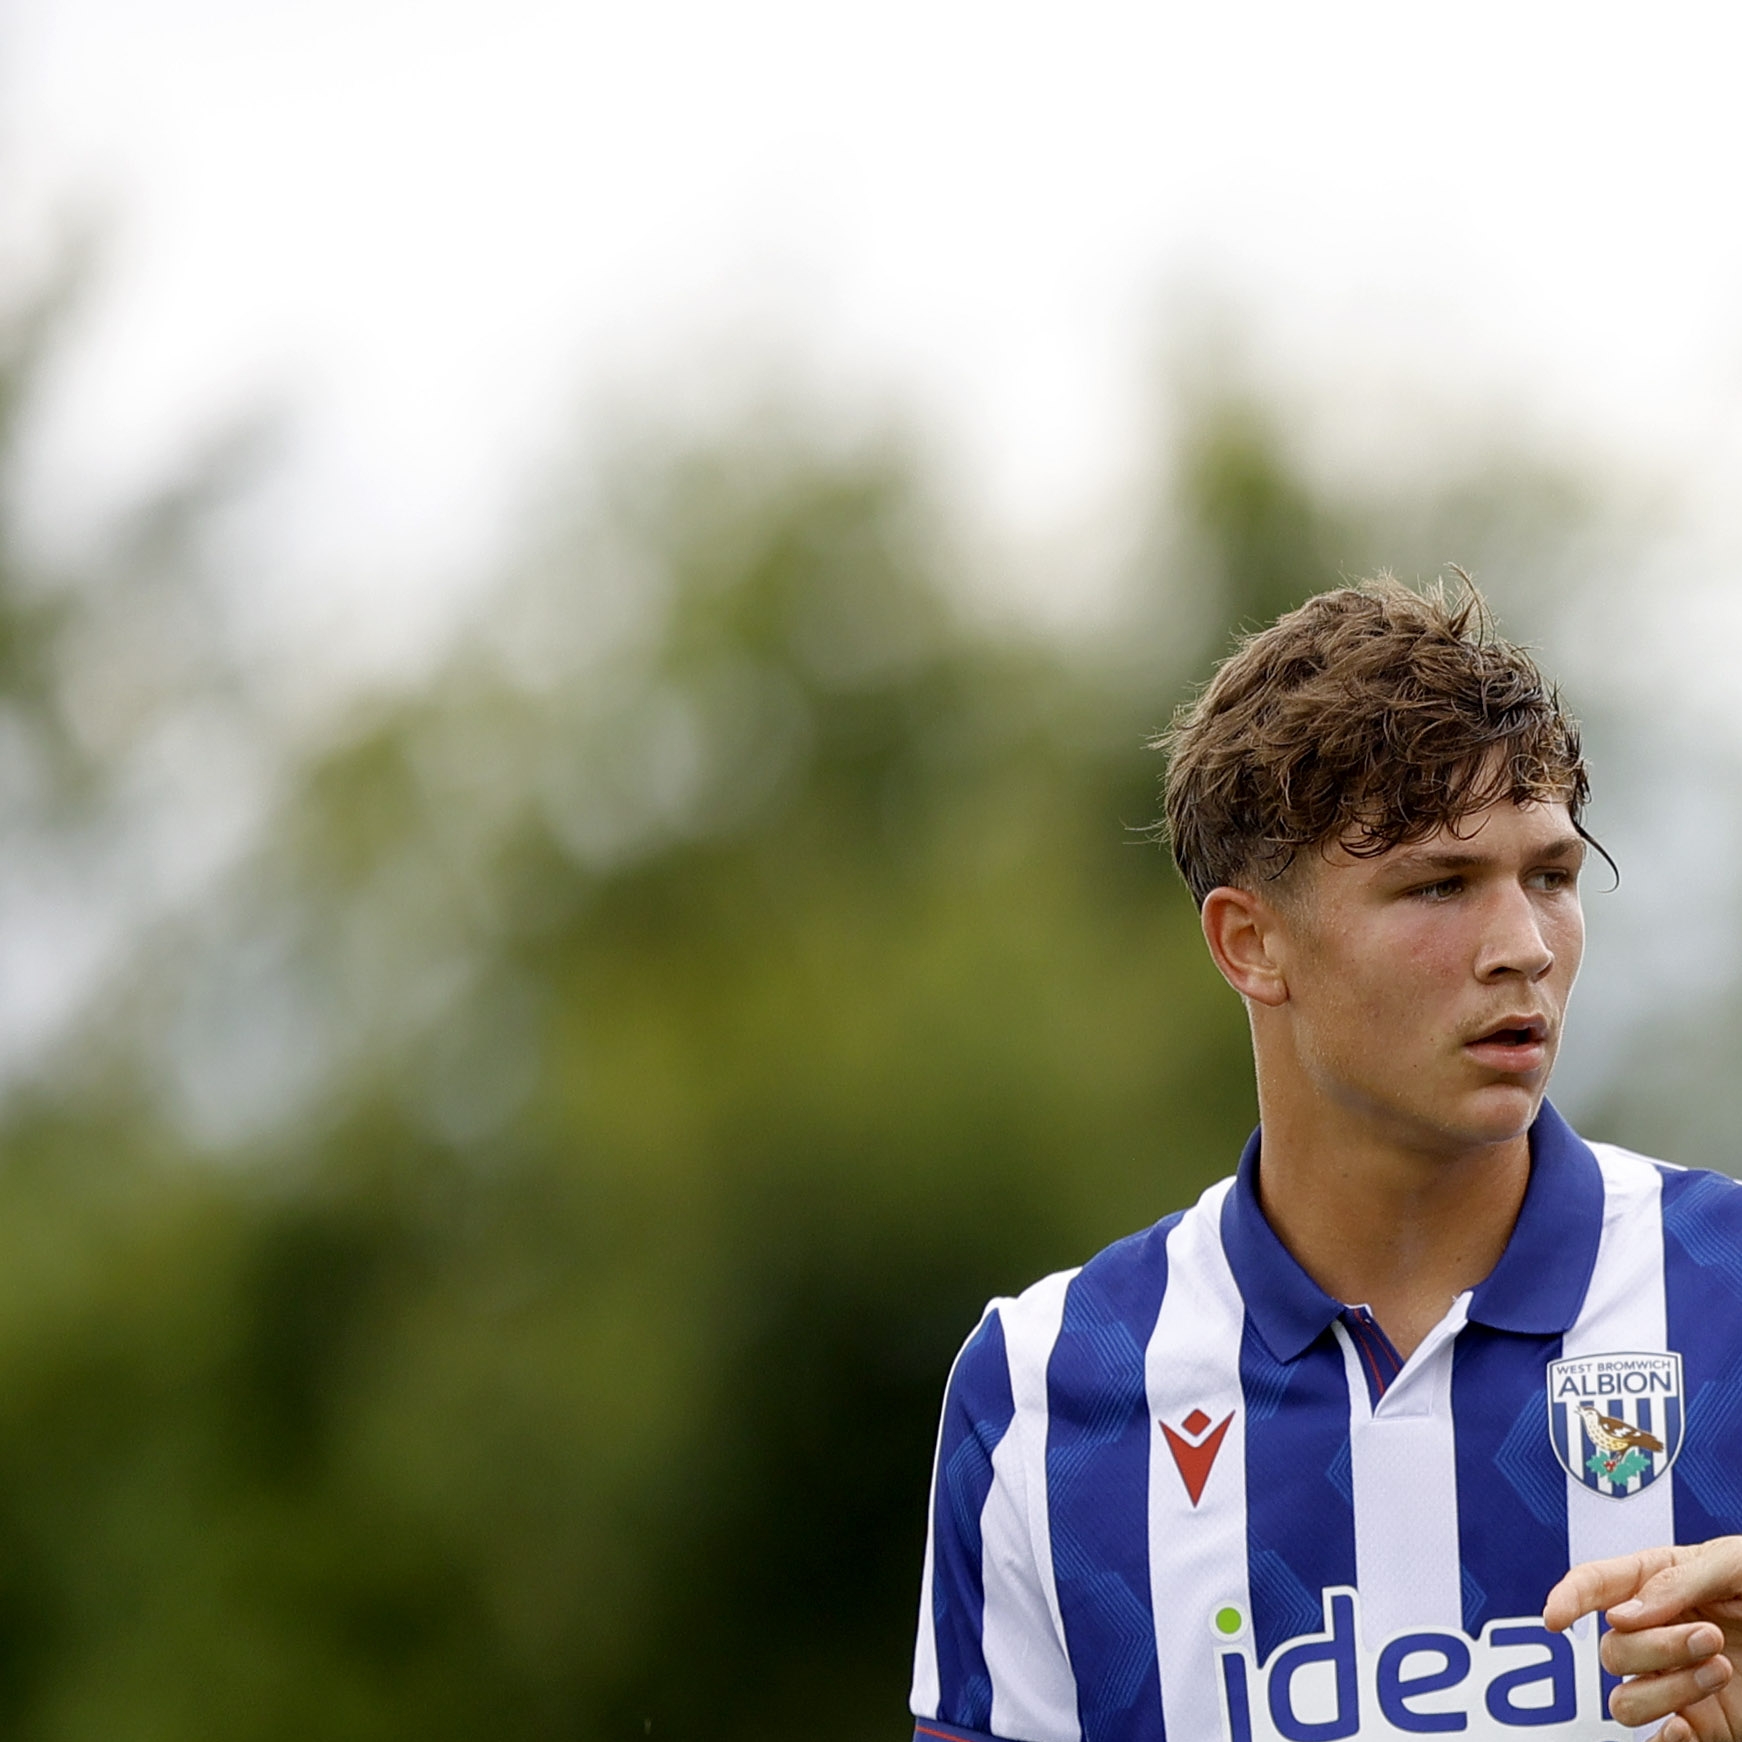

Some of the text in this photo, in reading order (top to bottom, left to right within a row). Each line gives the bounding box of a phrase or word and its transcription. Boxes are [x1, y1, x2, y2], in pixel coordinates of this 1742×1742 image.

[1556, 1360, 1671, 1375] WEST BROMWICH
[1558, 1371, 1672, 1398] ALBION
